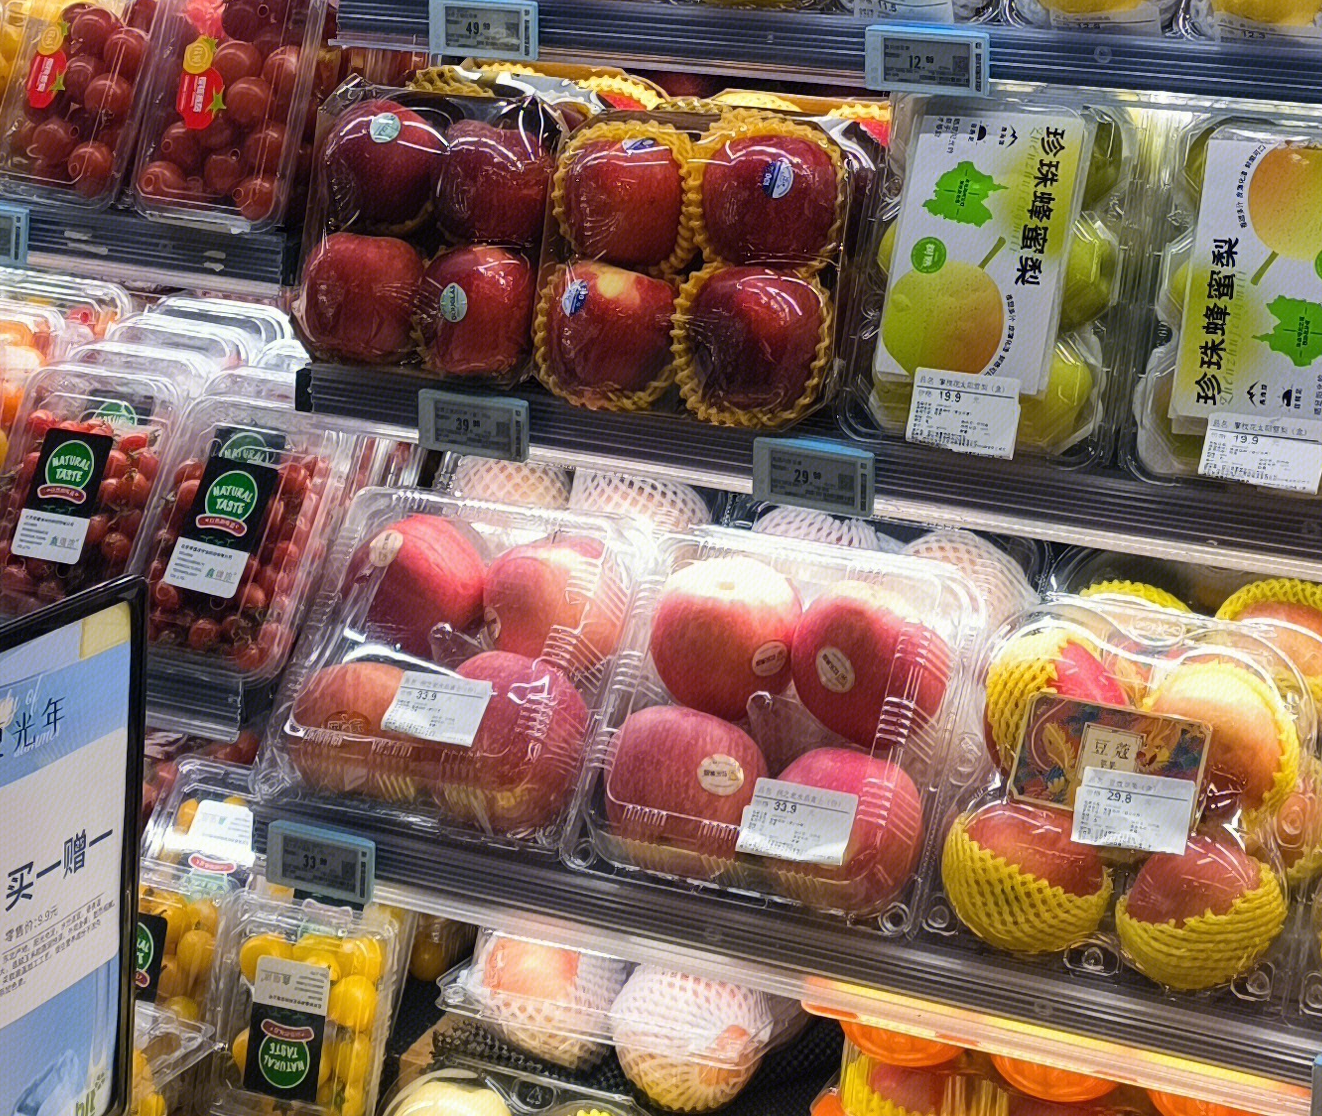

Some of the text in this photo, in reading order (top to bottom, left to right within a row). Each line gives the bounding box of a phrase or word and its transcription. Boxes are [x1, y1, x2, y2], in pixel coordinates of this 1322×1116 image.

[1014, 125, 1067, 287] 珍珠蜂蜜梨
[1195, 237, 1239, 406] 珍珠蜂蜜梨
[938, 390, 962, 403] 19.9
[1233, 434, 1260, 446] 19.9
[51, 455, 91, 472] NATURAL
[55, 467, 84, 483] TASTE
[212, 484, 255, 504] NATURAL
[215, 497, 246, 515] TASTE
[415, 690, 438, 701] 33.9
[1091, 739, 1131, 760] 豆蔻
[1107, 790, 1132, 804] 29.8
[773, 800, 797, 814] 33.9
[5, 828, 114, 912] 买一赠一
[268, 1041, 300, 1059] TASTE
[262, 1053, 306, 1074] NATURAL
